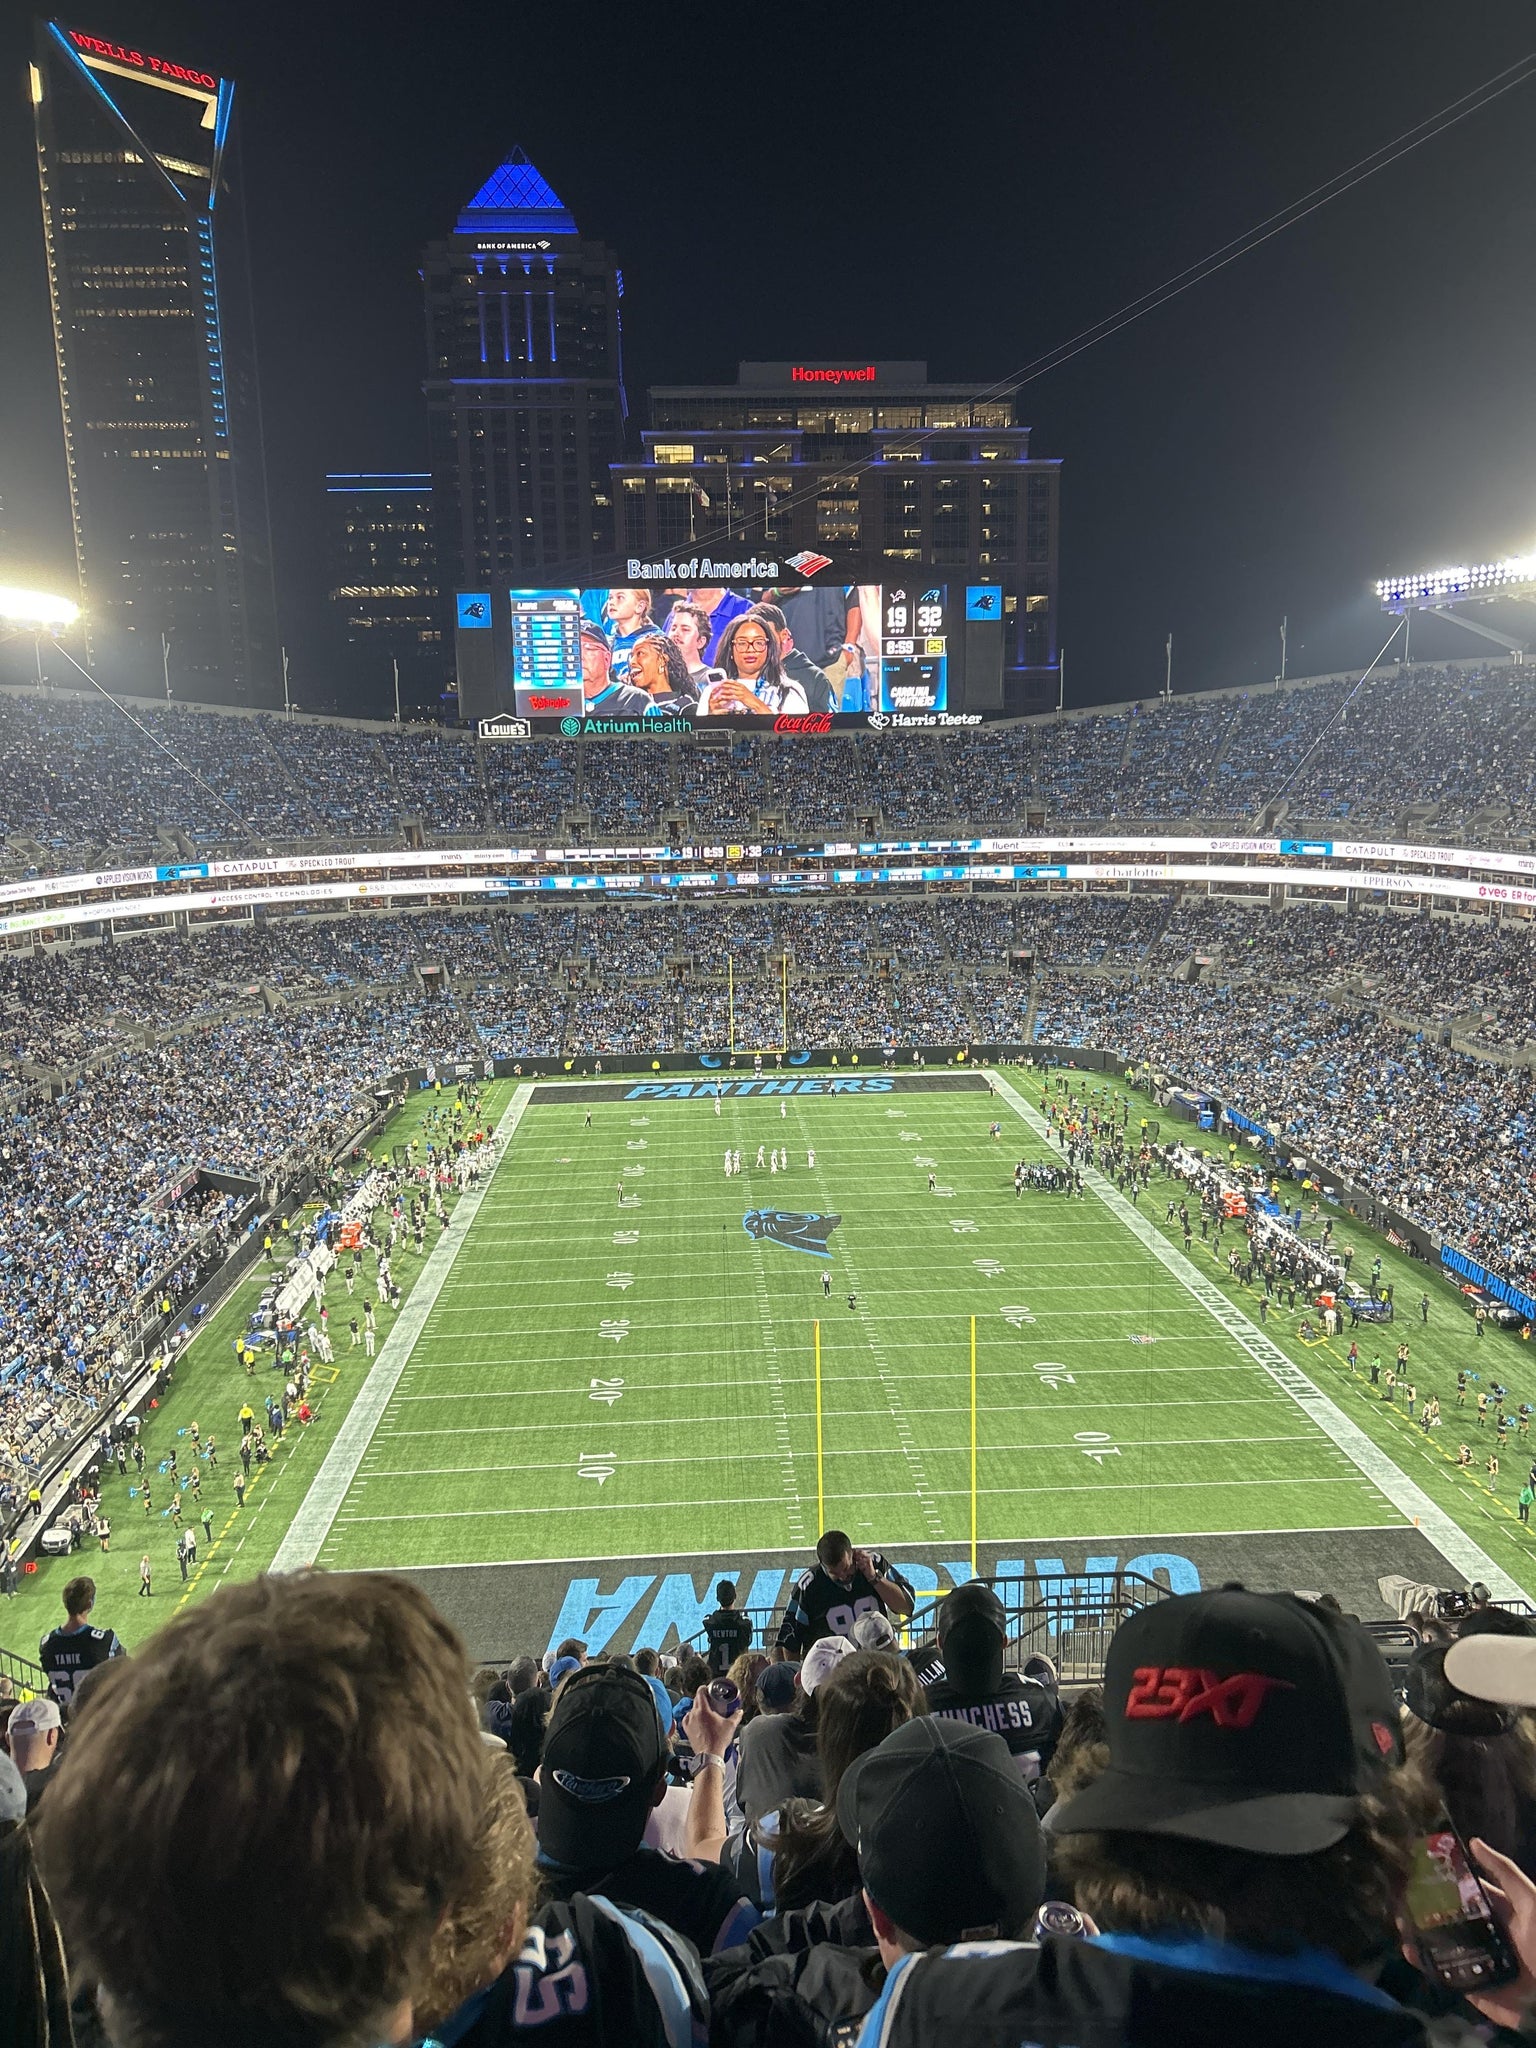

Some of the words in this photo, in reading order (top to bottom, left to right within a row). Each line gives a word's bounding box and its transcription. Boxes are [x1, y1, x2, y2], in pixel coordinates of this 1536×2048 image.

[68, 30, 145, 67] WELLS
[148, 55, 216, 89] FARGO
[792, 366, 876, 385] Honeywell
[627, 558, 677, 579] Bank
[678, 558, 698, 579] of
[700, 557, 779, 579] America
[887, 606, 907, 628] 19
[918, 606, 942, 627] 32
[890, 686, 930, 698] CAROLINA
[528, 695, 571, 711] Bojangles
[894, 696, 936, 707] PANTHERS
[584, 719, 640, 733] Atrium
[642, 718, 692, 733] Health
[892, 713, 936, 727] Harris
[938, 712, 983, 725] Teeter
[992, 841, 1019, 850] fluent
[1345, 845, 1395, 856] CATAPULT
[300, 858, 334, 868] SPECKLED
[335, 857, 355, 866] TROUT
[1410, 850, 1436, 860] SPECKLED
[1437, 852, 1455, 861] TROUT
[224, 861, 278, 873] CATAPULT
[1363, 876, 1413, 888] EPPERSON
[218, 894, 242, 902] ACCESS
[244, 892, 272, 900] CONTROL
[275, 888, 333, 898] TECHNOLOGIES
[1512, 890, 1522, 899] ER
[623, 1079, 896, 1100] PANTHERS
[949, 1220, 979, 1233] 50
[612, 1230, 640, 1244] 50
[971, 1259, 1006, 1274] 40
[605, 1271, 635, 1287] 40
[1441, 1245, 1485, 1287] CAROLINA
[1485, 1273, 1536, 1320] PANTHERS
[1191, 1284, 1248, 1326] CANCER
[1000, 1305, 1037, 1324] 30
[598, 1320, 631, 1338] 30
[1032, 1362, 1077, 1384] 20
[1233, 1332, 1322, 1400] INTERCEPT
[588, 1378, 625, 1401] 20
[1073, 1431, 1123, 1456] 10
[576, 1451, 617, 1478] 10
[712, 1629, 738, 1639] NEWTON
[54, 1653, 81, 1665] YANIK
